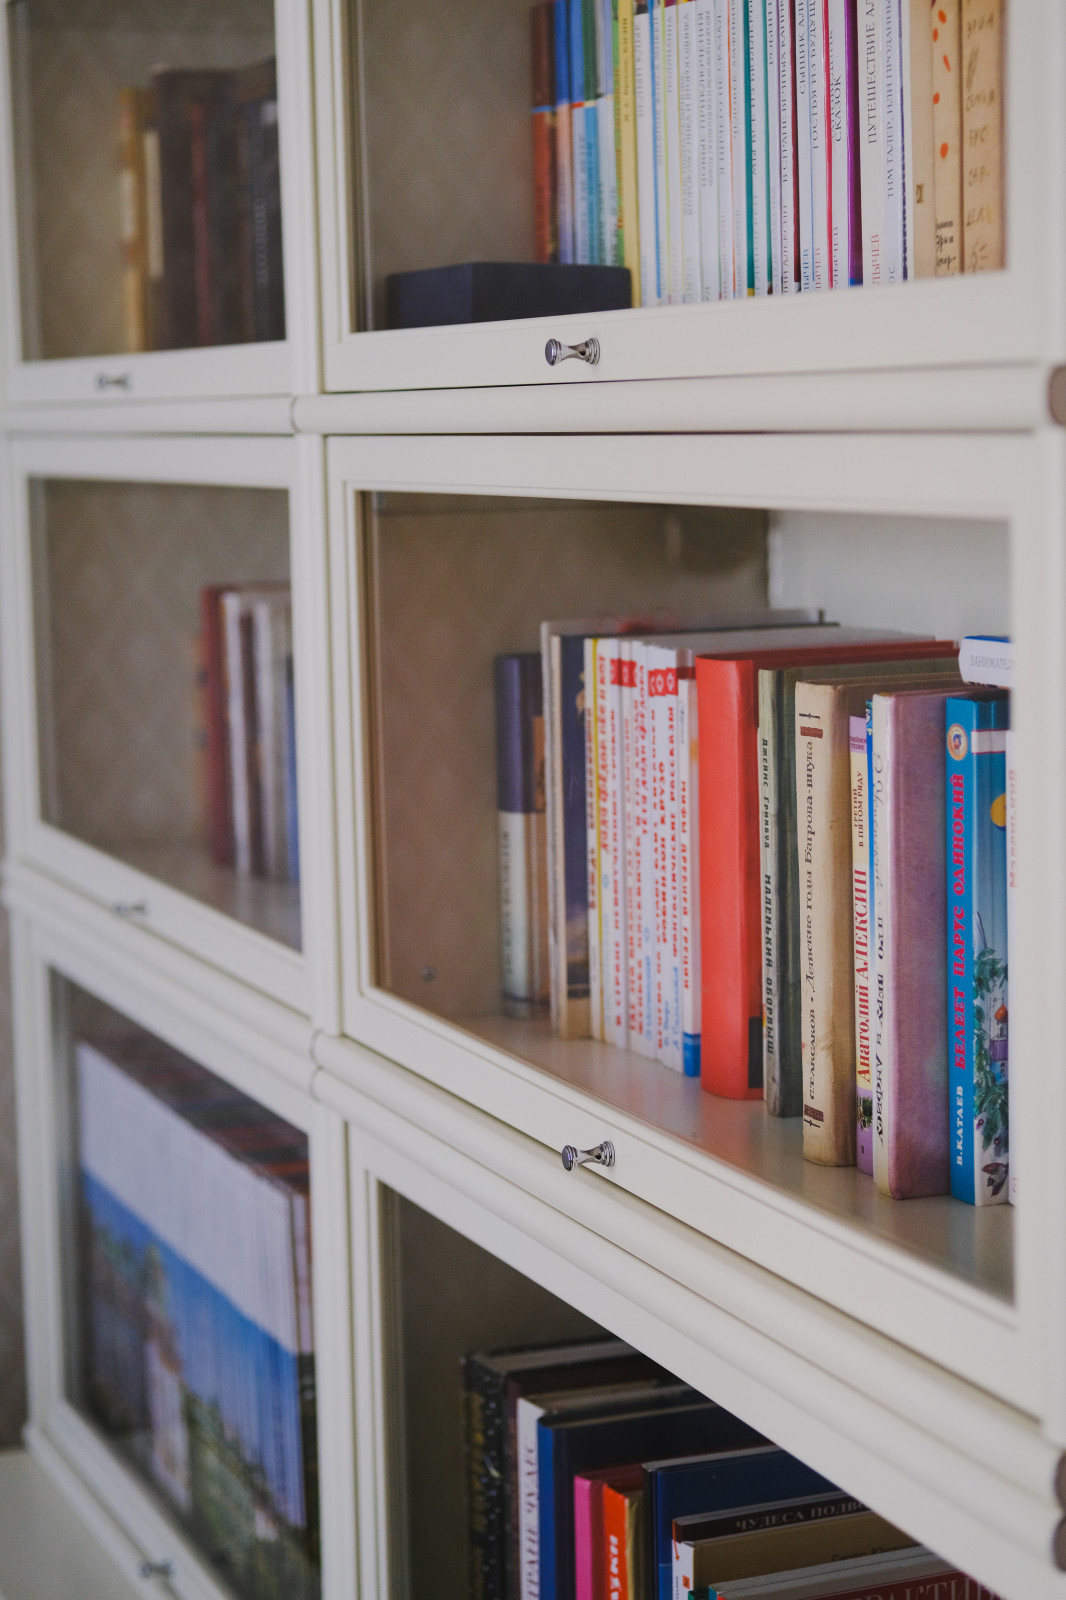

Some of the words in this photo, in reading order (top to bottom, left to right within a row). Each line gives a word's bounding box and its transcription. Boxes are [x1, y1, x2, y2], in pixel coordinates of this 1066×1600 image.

[798, 32, 806, 95] СЫЩИК
[865, 22, 878, 144] ПУТЕШЕСТВИЕ
[810, 90, 819, 150] ГОСТЬЯ
[833, 73, 842, 143] СКАЗОК
[657, 760, 667, 825] КРУЗО
[804, 741, 816, 864] Багрова-внука
[950, 773, 965, 897] ОДИНОКИЙ
[660, 836, 669, 944] РОБИНЗОН
[764, 873, 774, 968] МАЛЕНЬКИЙ
[805, 870, 814, 910] годы
[853, 867, 869, 982] АЛЕКСИН
[805, 915, 815, 994] Детские
[953, 905, 965, 978] ПАРУС
[766, 976, 774, 1055] ОБОРВЫШ
[855, 984, 871, 1085] Анатолий
[876, 972, 884, 1028] ВЕРУ
[953, 986, 966, 1071] БЕЛЕЕТ
[736, 1511, 805, 1531] ЧУДЕСА
